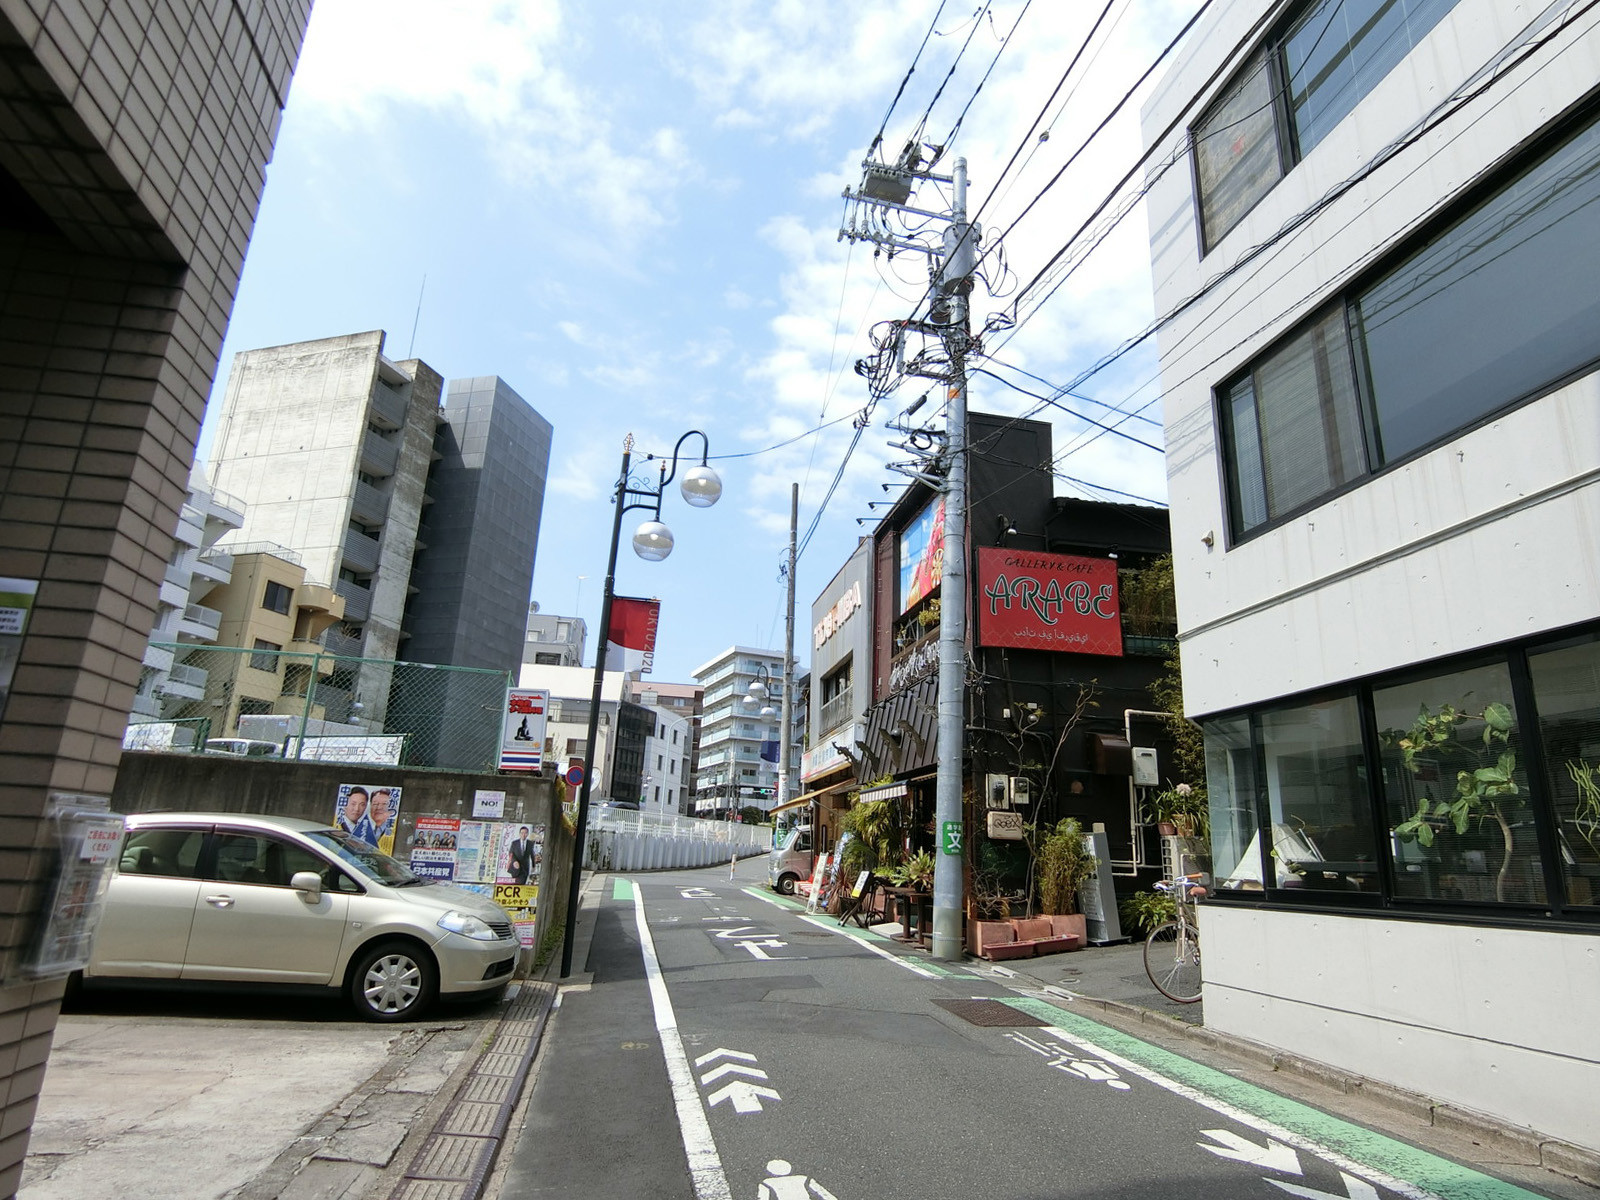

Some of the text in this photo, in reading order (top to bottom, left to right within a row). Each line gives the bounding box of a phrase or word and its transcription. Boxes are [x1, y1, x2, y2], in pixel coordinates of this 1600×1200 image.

[1004, 557, 1055, 570] GALLERY
[984, 574, 1115, 626] ARABE
[641, 643, 655, 675] 2020
[336, 785, 351, 827] 中田たか
[947, 831, 961, 849] 文
[413, 866, 450, 877] 日本共産党
[496, 886, 520, 898] PCR
